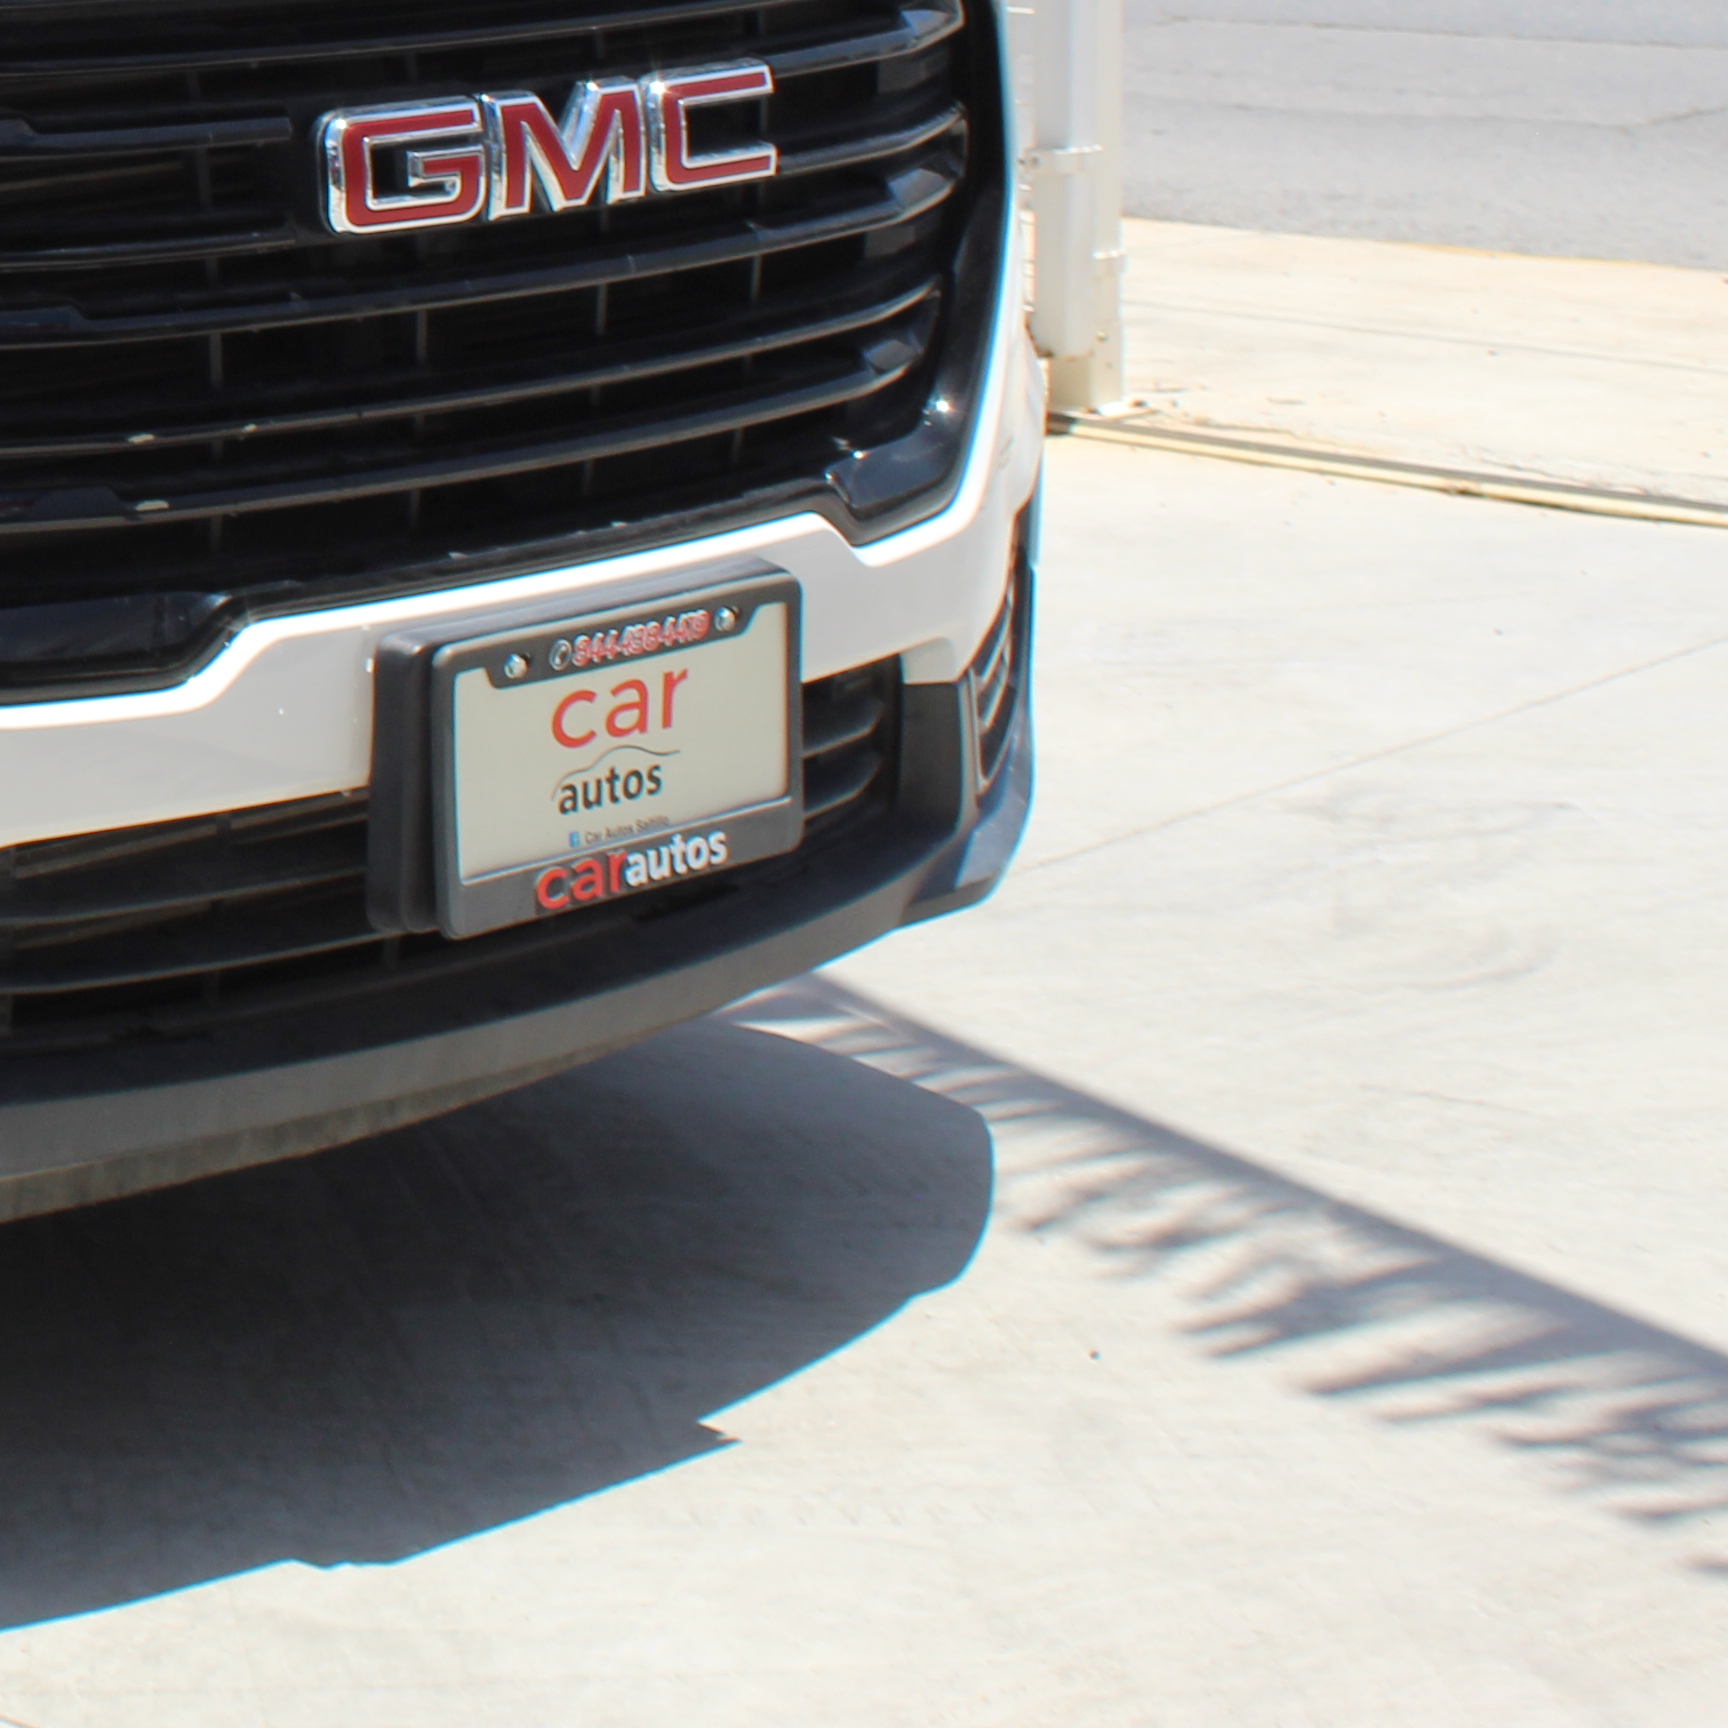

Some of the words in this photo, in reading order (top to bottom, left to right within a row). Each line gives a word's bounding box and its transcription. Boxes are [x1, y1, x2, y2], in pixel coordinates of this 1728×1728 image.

[320, 57, 778, 234] GMC
[551, 667, 689, 749] car
[558, 763, 664, 815] autos
